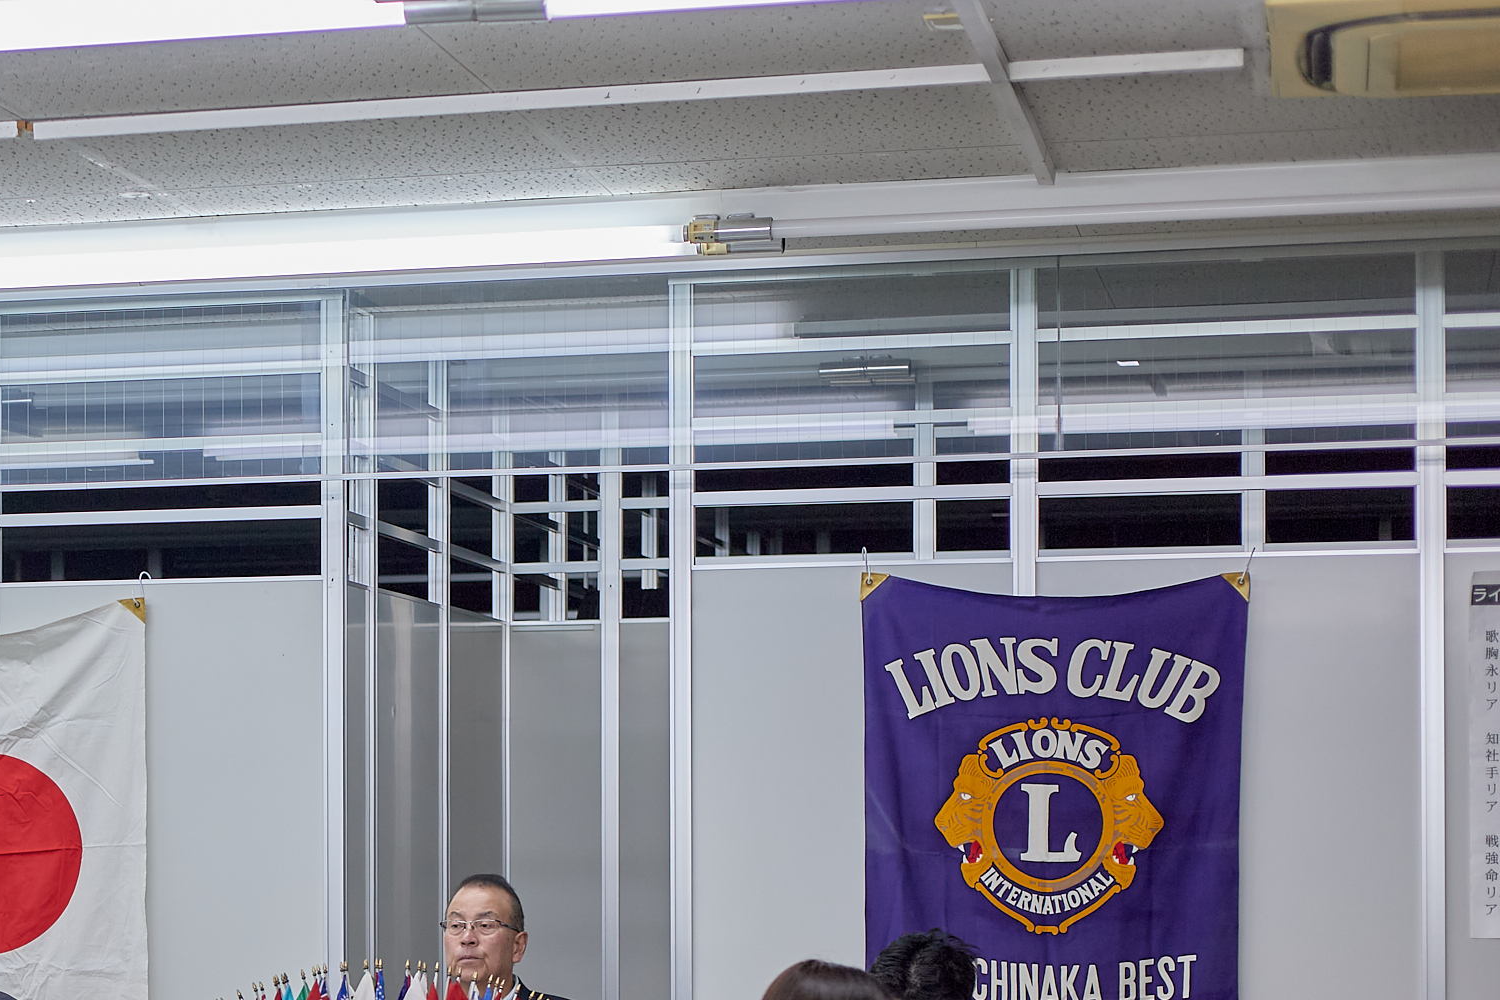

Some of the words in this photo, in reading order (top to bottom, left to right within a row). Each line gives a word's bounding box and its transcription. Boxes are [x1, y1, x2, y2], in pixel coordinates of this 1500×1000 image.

[884, 636, 1059, 720] LIONS
[1066, 637, 1221, 724] CLUB
[988, 728, 1110, 770] LIONS
[1020, 783, 1082, 863] L
[979, 866, 1115, 915] INTERNATIONAL
